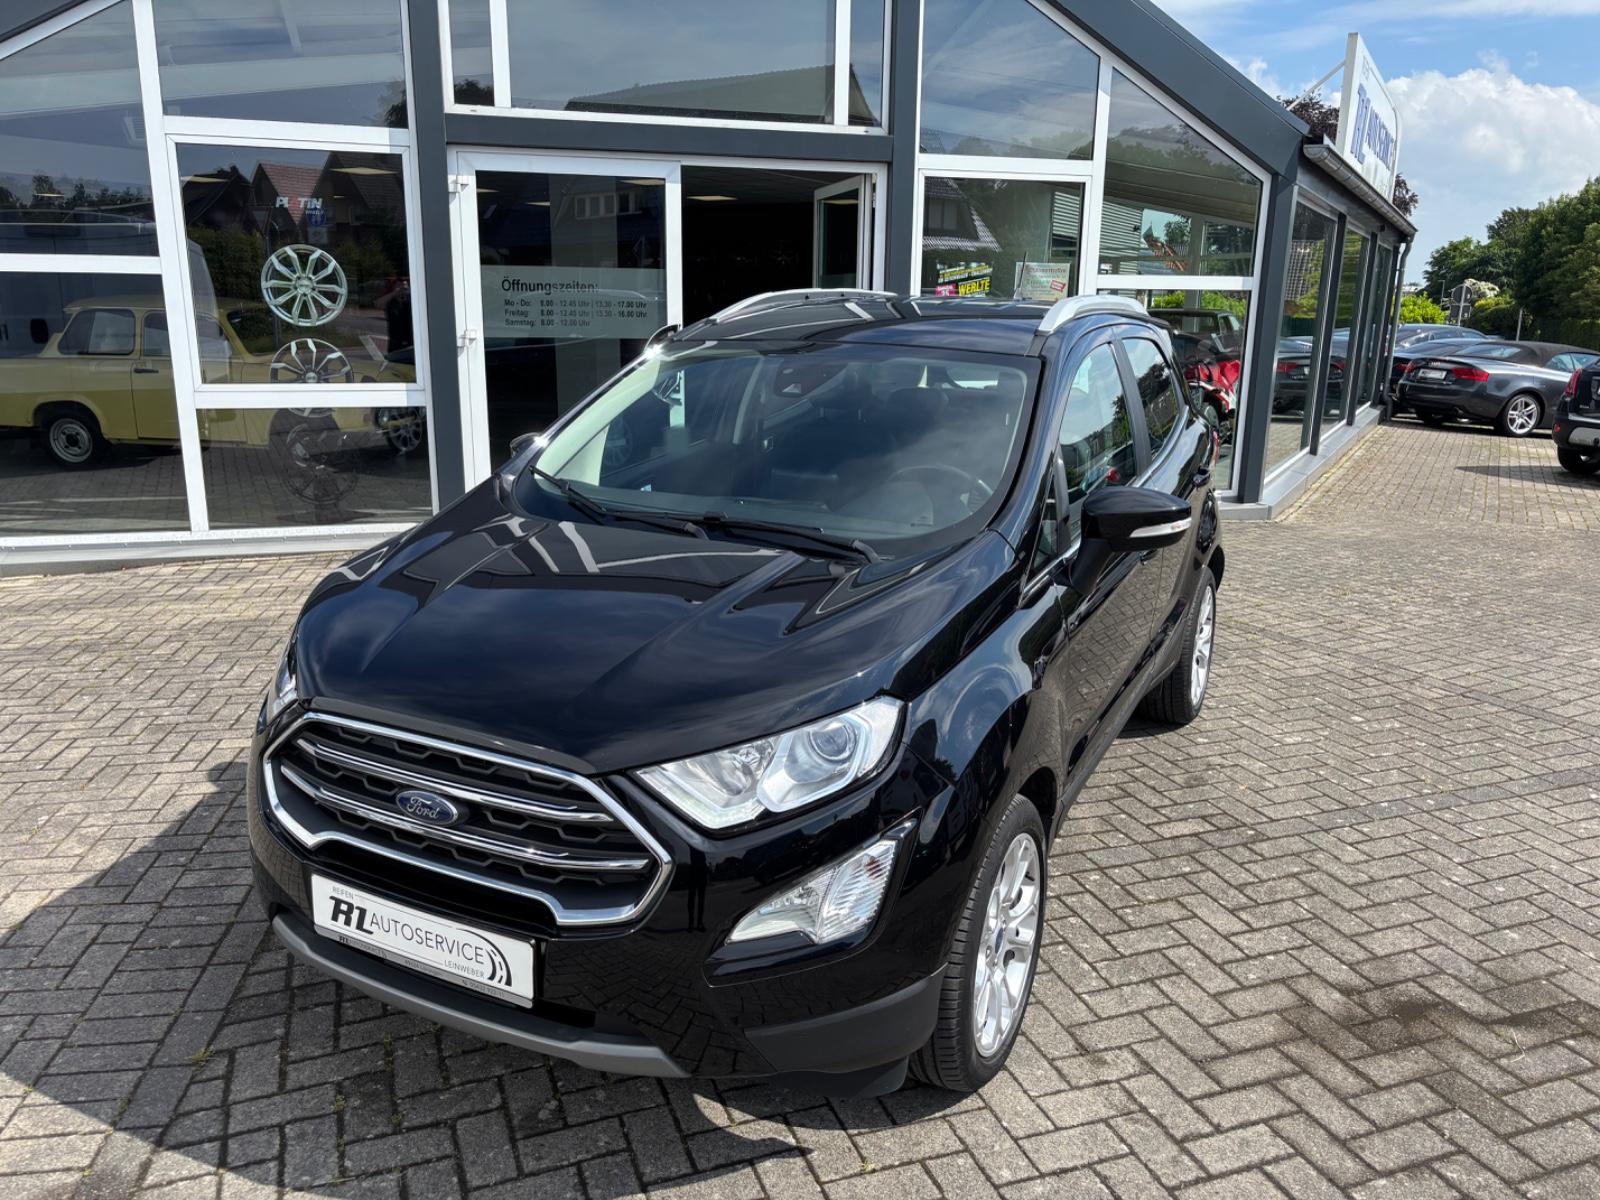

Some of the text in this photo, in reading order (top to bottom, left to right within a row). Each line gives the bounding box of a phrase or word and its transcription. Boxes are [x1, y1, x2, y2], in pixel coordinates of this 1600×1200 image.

[501, 276, 599, 296] Öffnungszeiten:
[635, 301, 648, 309] Uhr
[578, 319, 591, 327] Uhr
[635, 311, 648, 319] Uhr
[406, 796, 441, 819] Ford
[332, 886, 355, 900] REIFEN
[329, 895, 374, 935] RL
[370, 912, 485, 965] AUTOSERVICE
[444, 959, 485, 979] LEINWEBER
